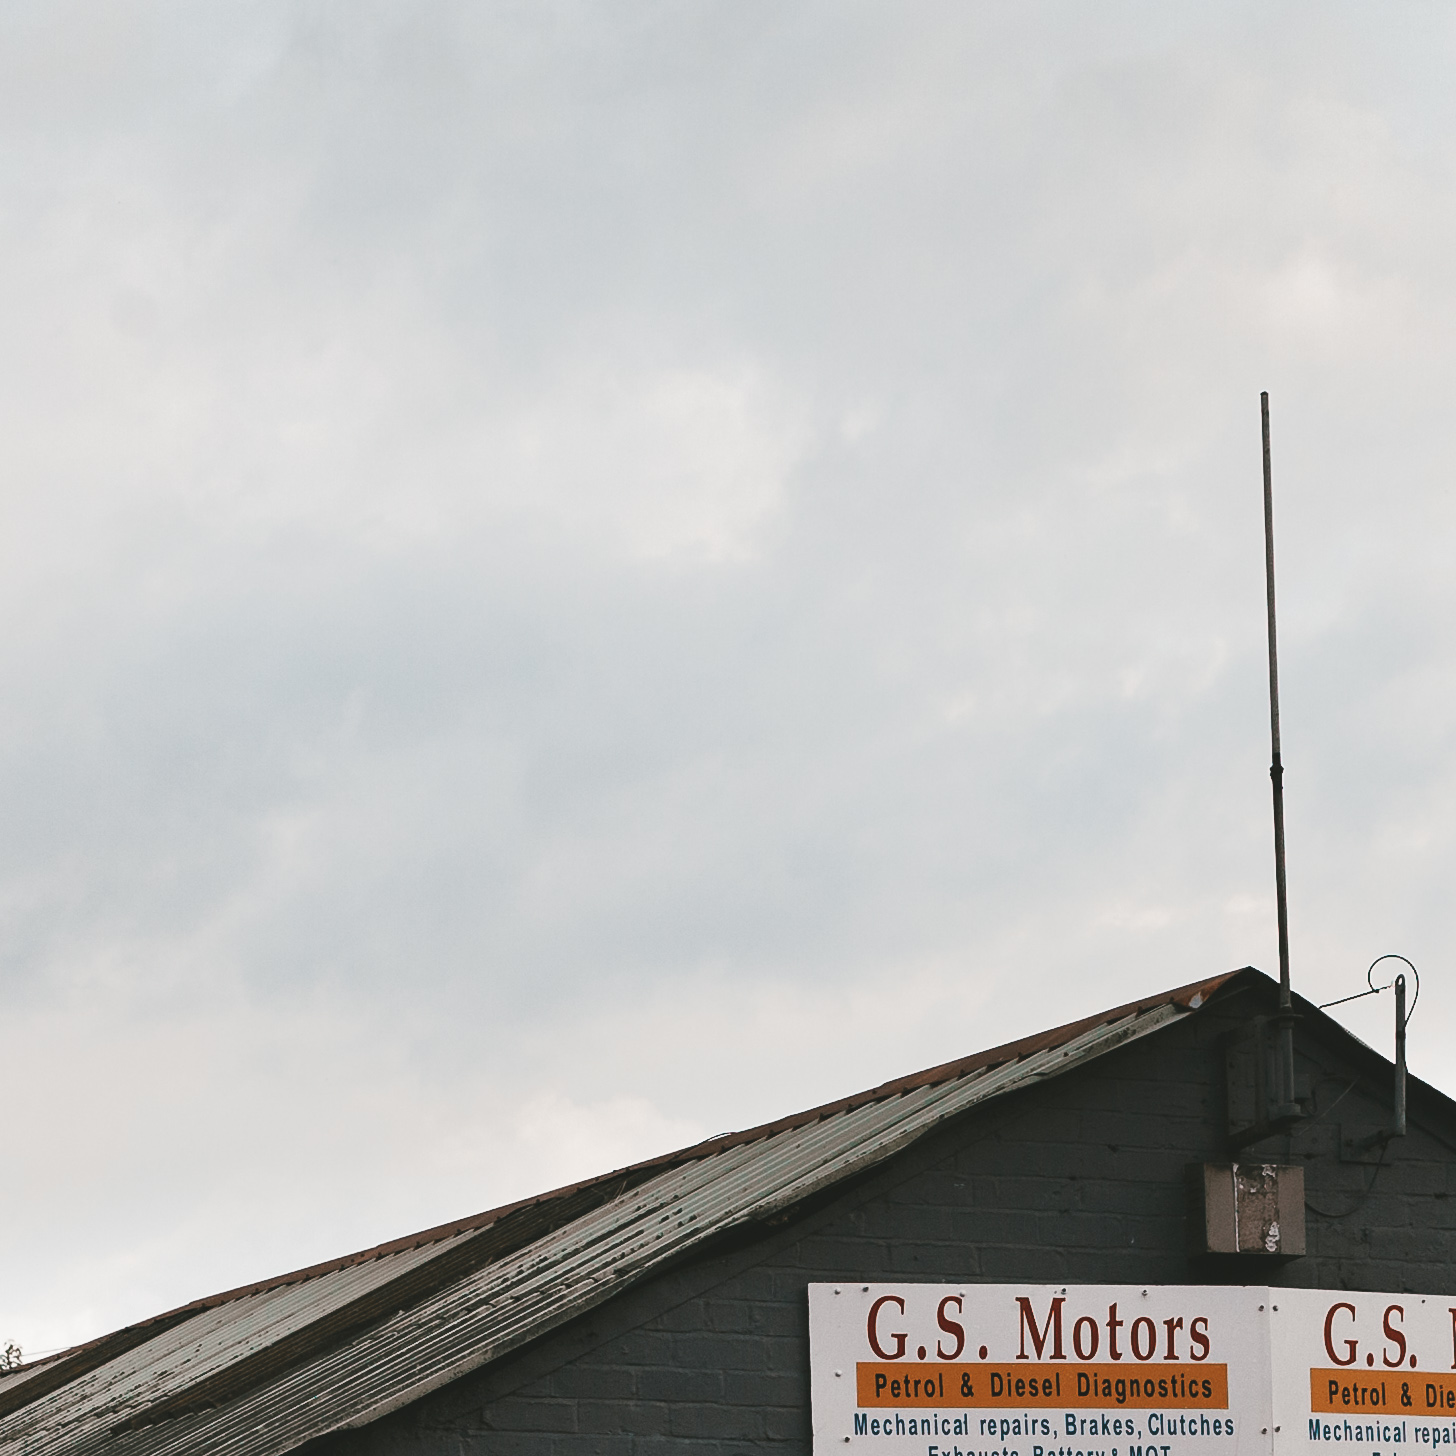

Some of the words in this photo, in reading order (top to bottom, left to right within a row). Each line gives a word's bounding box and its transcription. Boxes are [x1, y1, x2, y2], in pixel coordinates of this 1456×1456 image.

[867, 1295, 988, 1360] G.S.
[1015, 1297, 1211, 1361] Motors
[1324, 1303, 1417, 1368] G.S.
[875, 1372, 943, 1398] Petrol
[961, 1373, 974, 1397] &
[991, 1372, 1061, 1398] Diesel
[1078, 1372, 1212, 1403] Diagnostics
[1329, 1380, 1386, 1406] Petrol
[1401, 1383, 1413, 1407] &
[854, 1414, 968, 1435] Mechanical
[980, 1414, 1058, 1440] repairs,
[1065, 1414, 1141, 1438] Brakes,
[1148, 1413, 1234, 1436] Clutches
[1309, 1419, 1406, 1443] Mechanical
